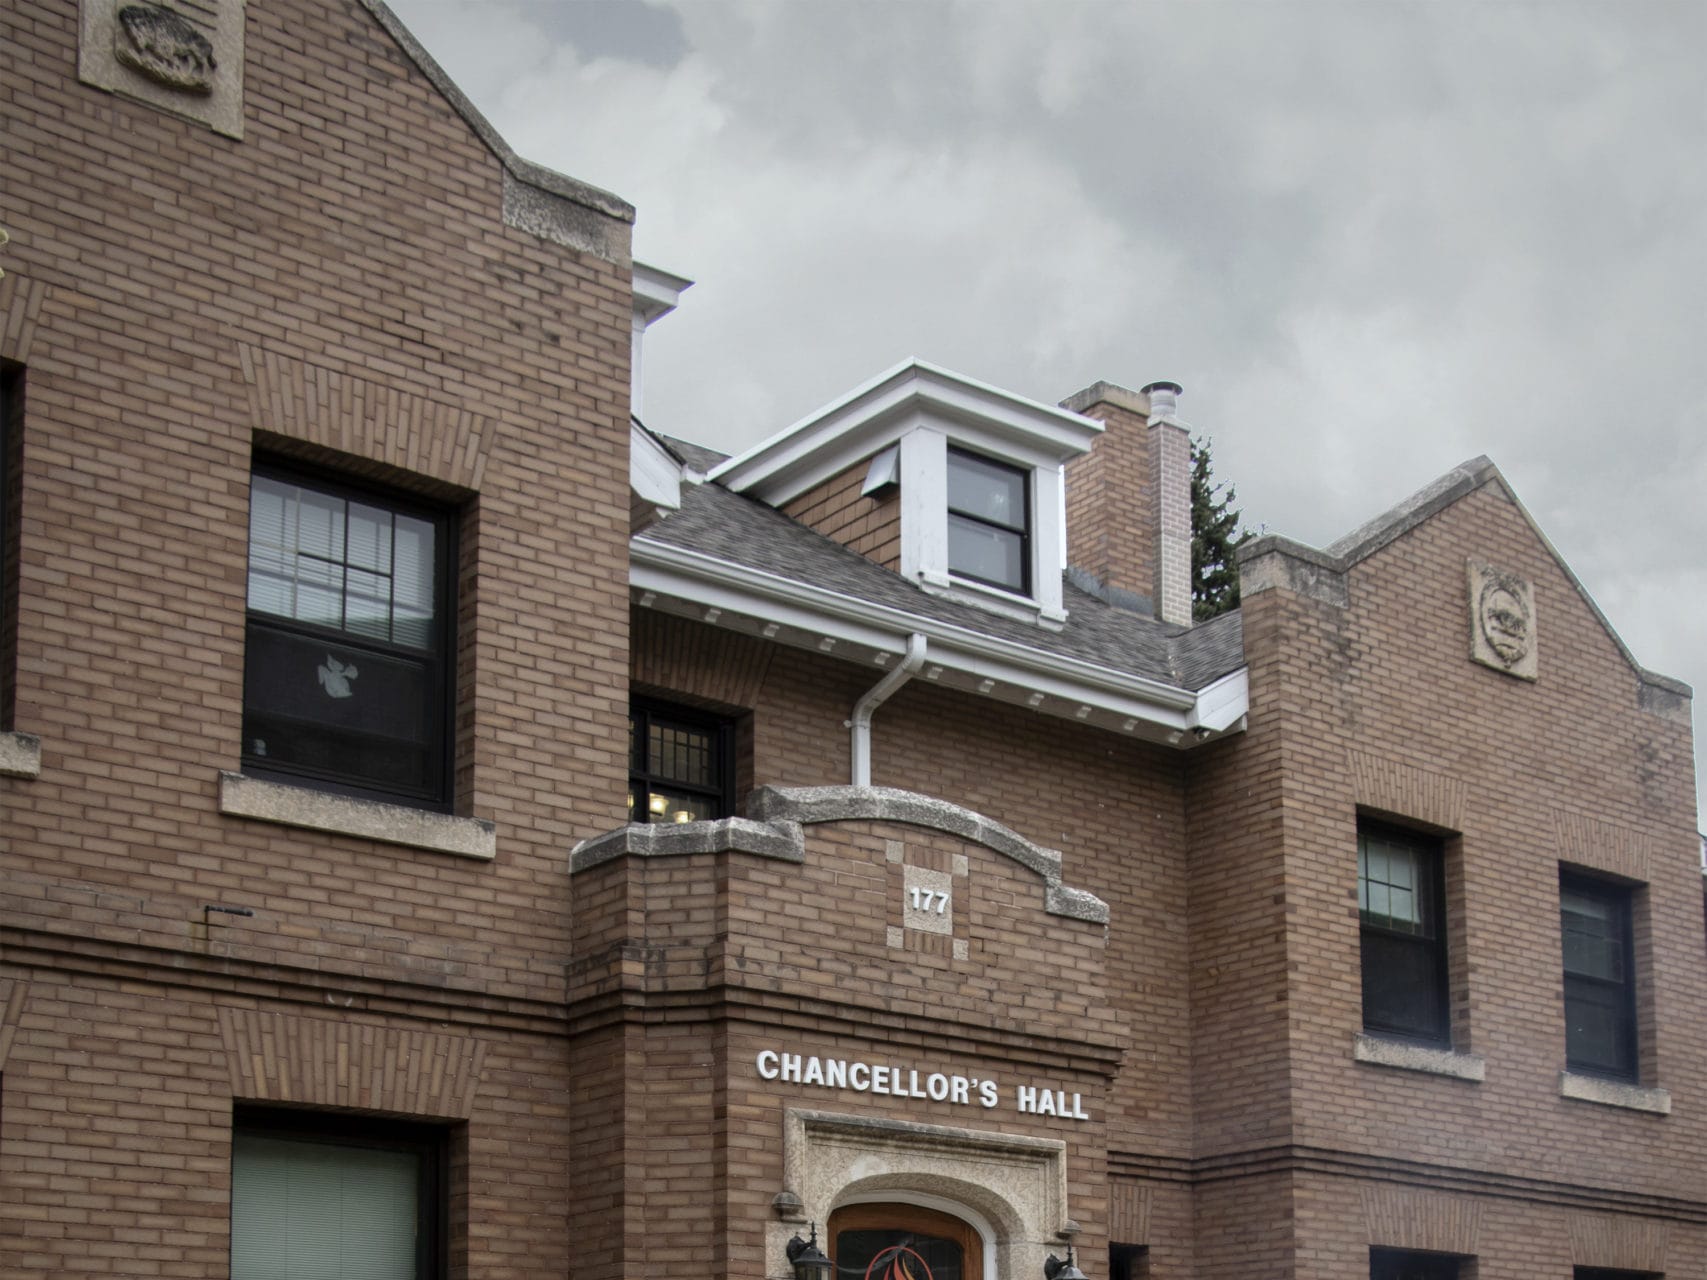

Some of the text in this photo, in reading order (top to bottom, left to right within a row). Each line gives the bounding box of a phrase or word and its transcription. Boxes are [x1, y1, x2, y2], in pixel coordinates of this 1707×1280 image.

[909, 887, 949, 914] 177
[756, 1049, 1089, 1120] CHANCELLOR'S HALL
